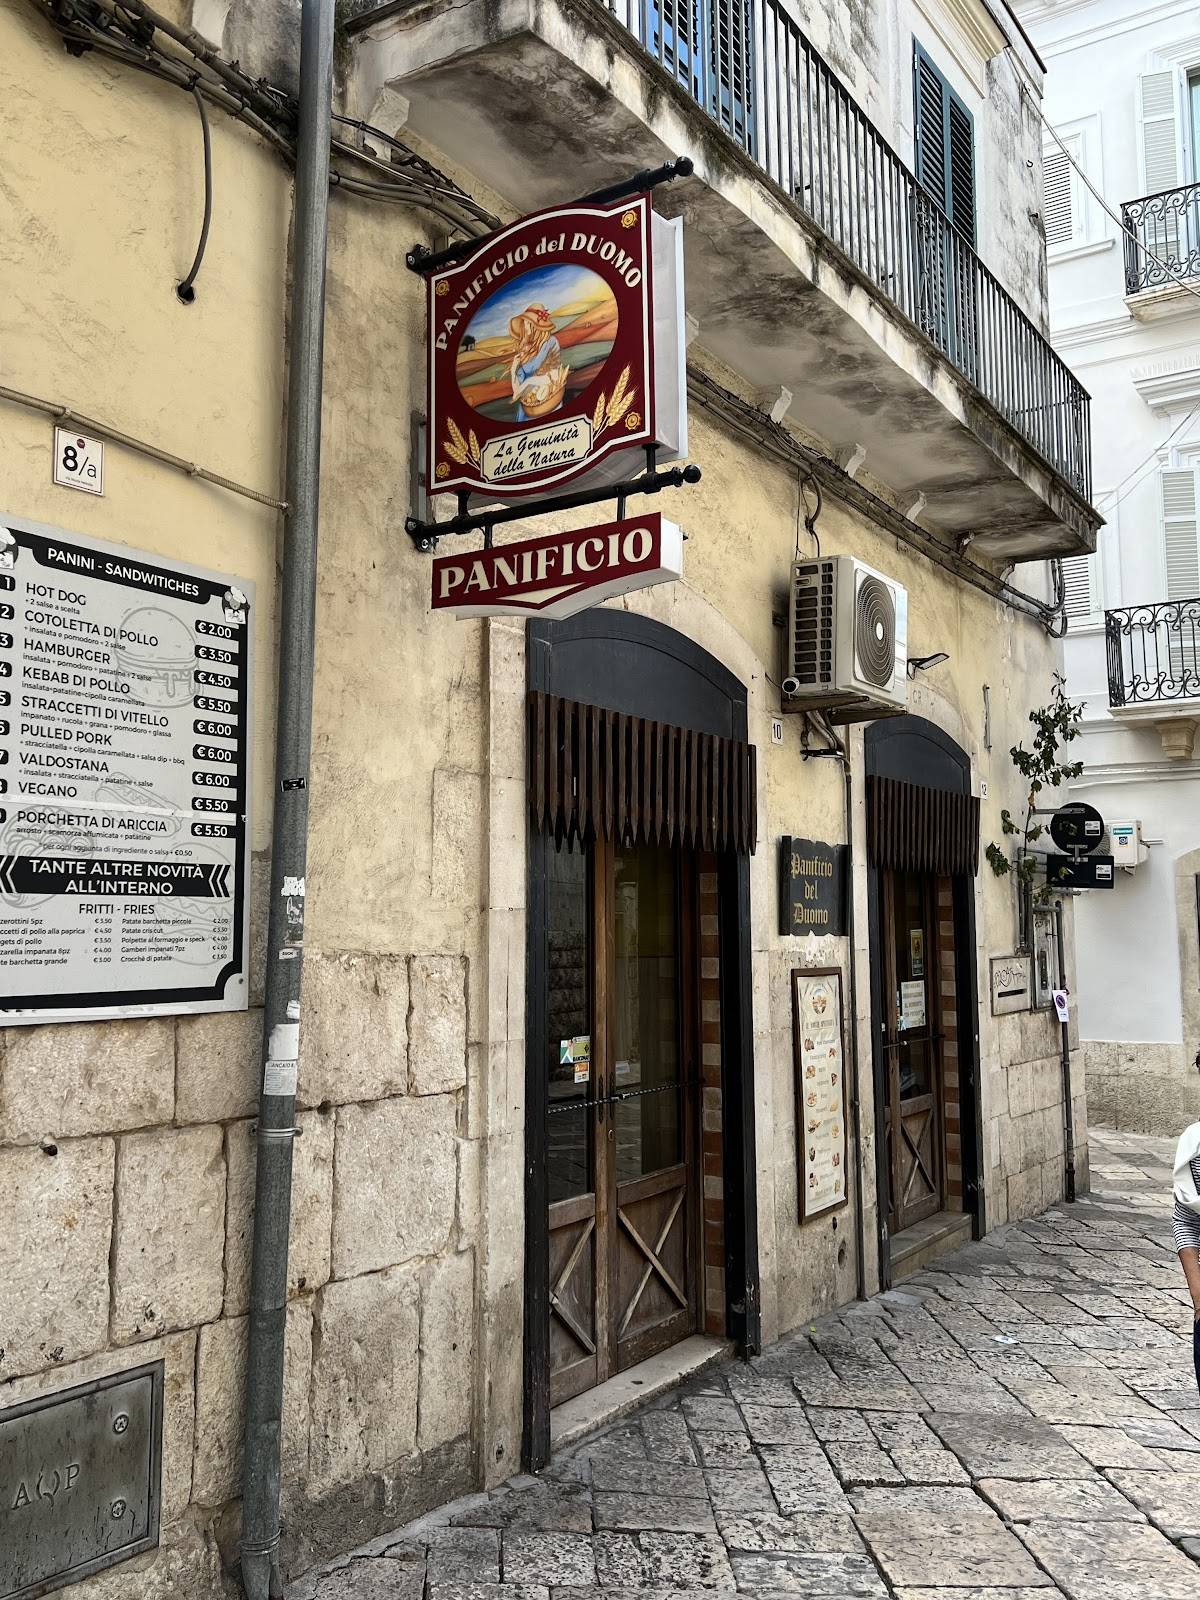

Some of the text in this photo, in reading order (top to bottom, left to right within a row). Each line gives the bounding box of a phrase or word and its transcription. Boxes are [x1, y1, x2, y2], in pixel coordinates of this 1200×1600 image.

[435, 232, 642, 350] PANIFICIO del DUOMO
[494, 424, 580, 459] La Genuinità
[62, 446, 96, 478] 8/a
[494, 448, 576, 476] della Natura
[48, 548, 94, 570] PANINI
[105, 562, 199, 596] SANDWITICHES
[439, 528, 653, 599] PANIFICIO
[4, 576, 86, 606] 1 HOT DOG
[36, 599, 54, 609] salse
[60, 605, 80, 614] scelta
[0, 606, 158, 647] 2 COTOLETTA DI POLLO
[208, 624, 232, 638] 2.00
[64, 634, 99, 645] pomodoro
[24, 637, 110, 664] HAMBURGER
[208, 649, 232, 663] 3.50
[22, 666, 70, 684] KEBAB
[72, 674, 86, 688] DI
[90, 678, 130, 694] POLLO
[208, 674, 232, 688] 4.50
[21, 695, 101, 718] STRACCETTI
[104, 708, 118, 720] DI
[120, 710, 169, 728] VITELLO
[208, 699, 232, 713] 5.50
[20, 724, 73, 740] PULLED
[76, 730, 112, 746] PORK
[207, 723, 232, 736] 6.00
[772, 722, 782, 740] 10
[19, 752, 109, 772] VALDOSTANA
[207, 748, 232, 761] 6.00
[18, 781, 78, 798] VEGANO
[205, 774, 230, 787] 6.00
[205, 800, 228, 812] 5.50
[17, 810, 98, 828] PORCHETTA
[102, 817, 114, 828] DI
[117, 818, 167, 832] ARICCIA
[204, 825, 228, 836] 5.50
[29, 860, 204, 879] TANTE ALTRE NOVITÀ
[790, 852, 833, 880] Panificio
[65, 880, 174, 895] ALL'INTERNO
[804, 880, 818, 900] del
[79, 904, 114, 914] FRITTI
[124, 904, 155, 914] FRIES
[794, 902, 828, 924] Duomo
[0, 938, 15, 946] gets
